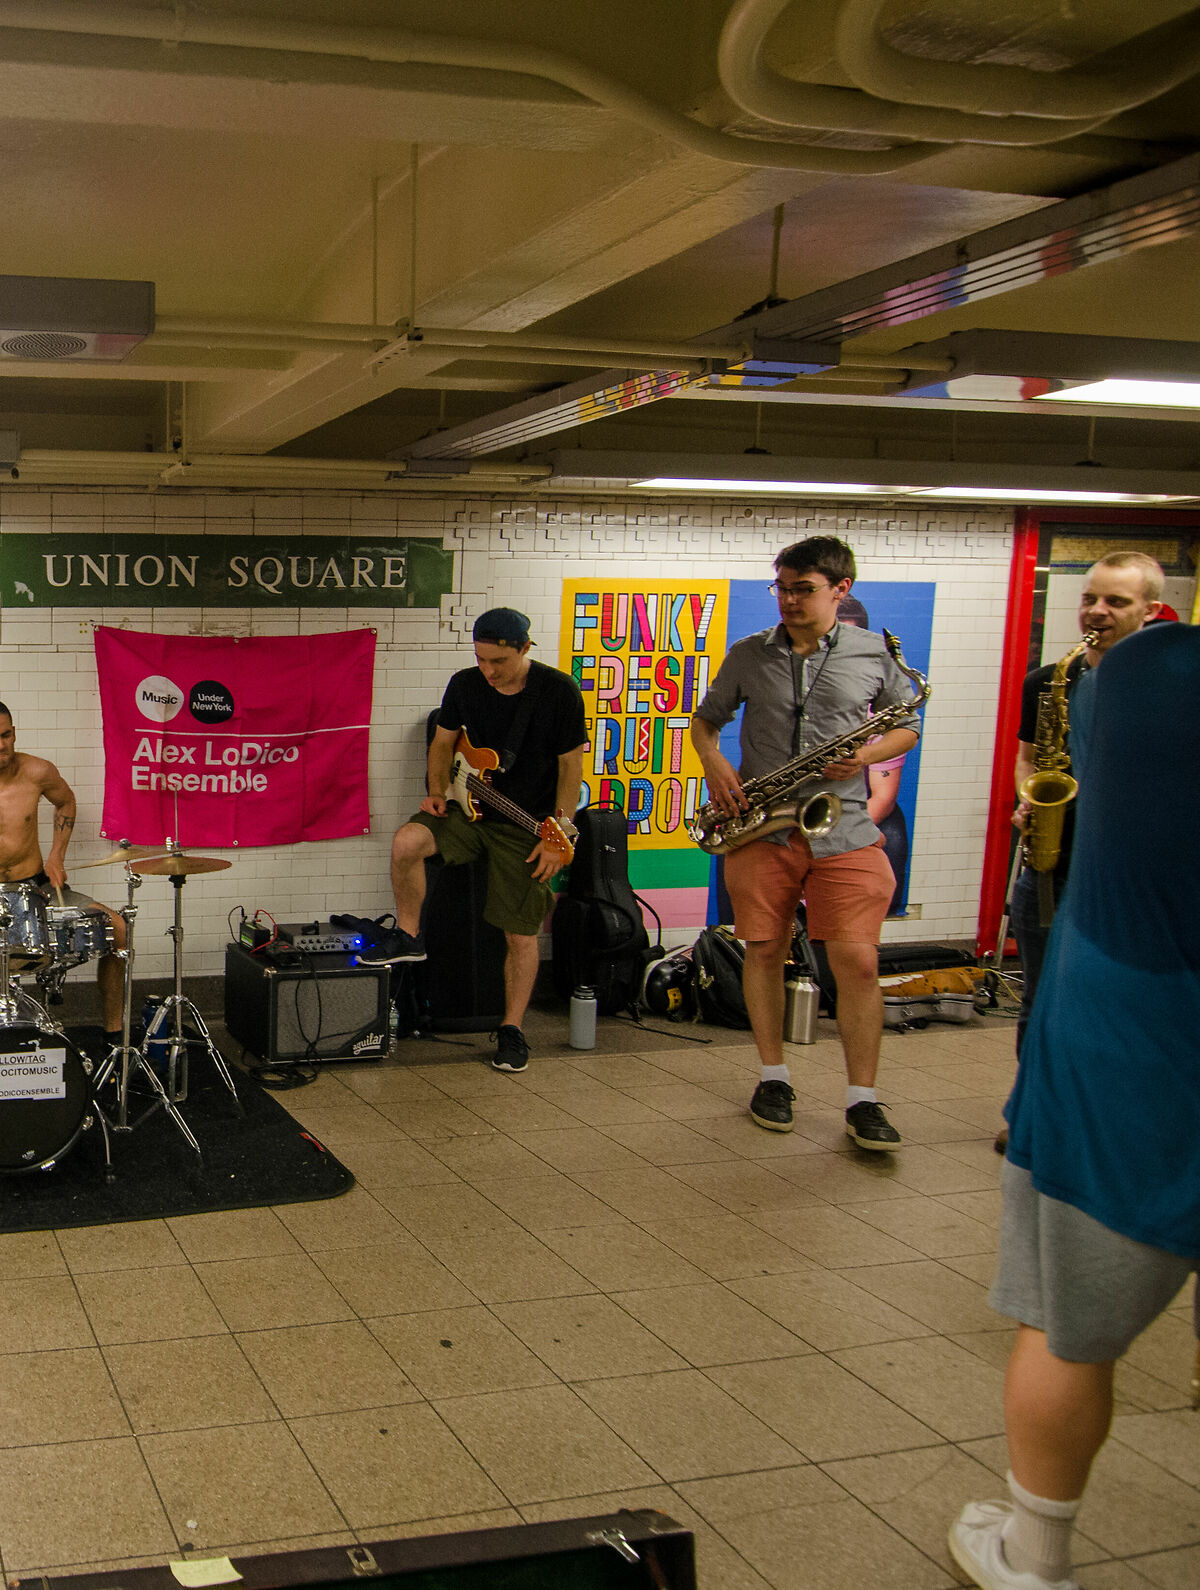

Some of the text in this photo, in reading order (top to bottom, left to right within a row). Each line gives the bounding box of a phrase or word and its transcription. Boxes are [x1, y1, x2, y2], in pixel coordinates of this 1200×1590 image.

[42, 554, 407, 594] UNION SQUARE
[572, 593, 717, 652] FUNKY
[142, 690, 178, 704] Music
[197, 693, 224, 702] Under
[571, 656, 710, 713] FRESH
[132, 737, 299, 766] Alex LoDico
[584, 717, 690, 775] RUIT
[132, 765, 268, 794] Ensemble
[352, 1032, 384, 1055] aguilar
